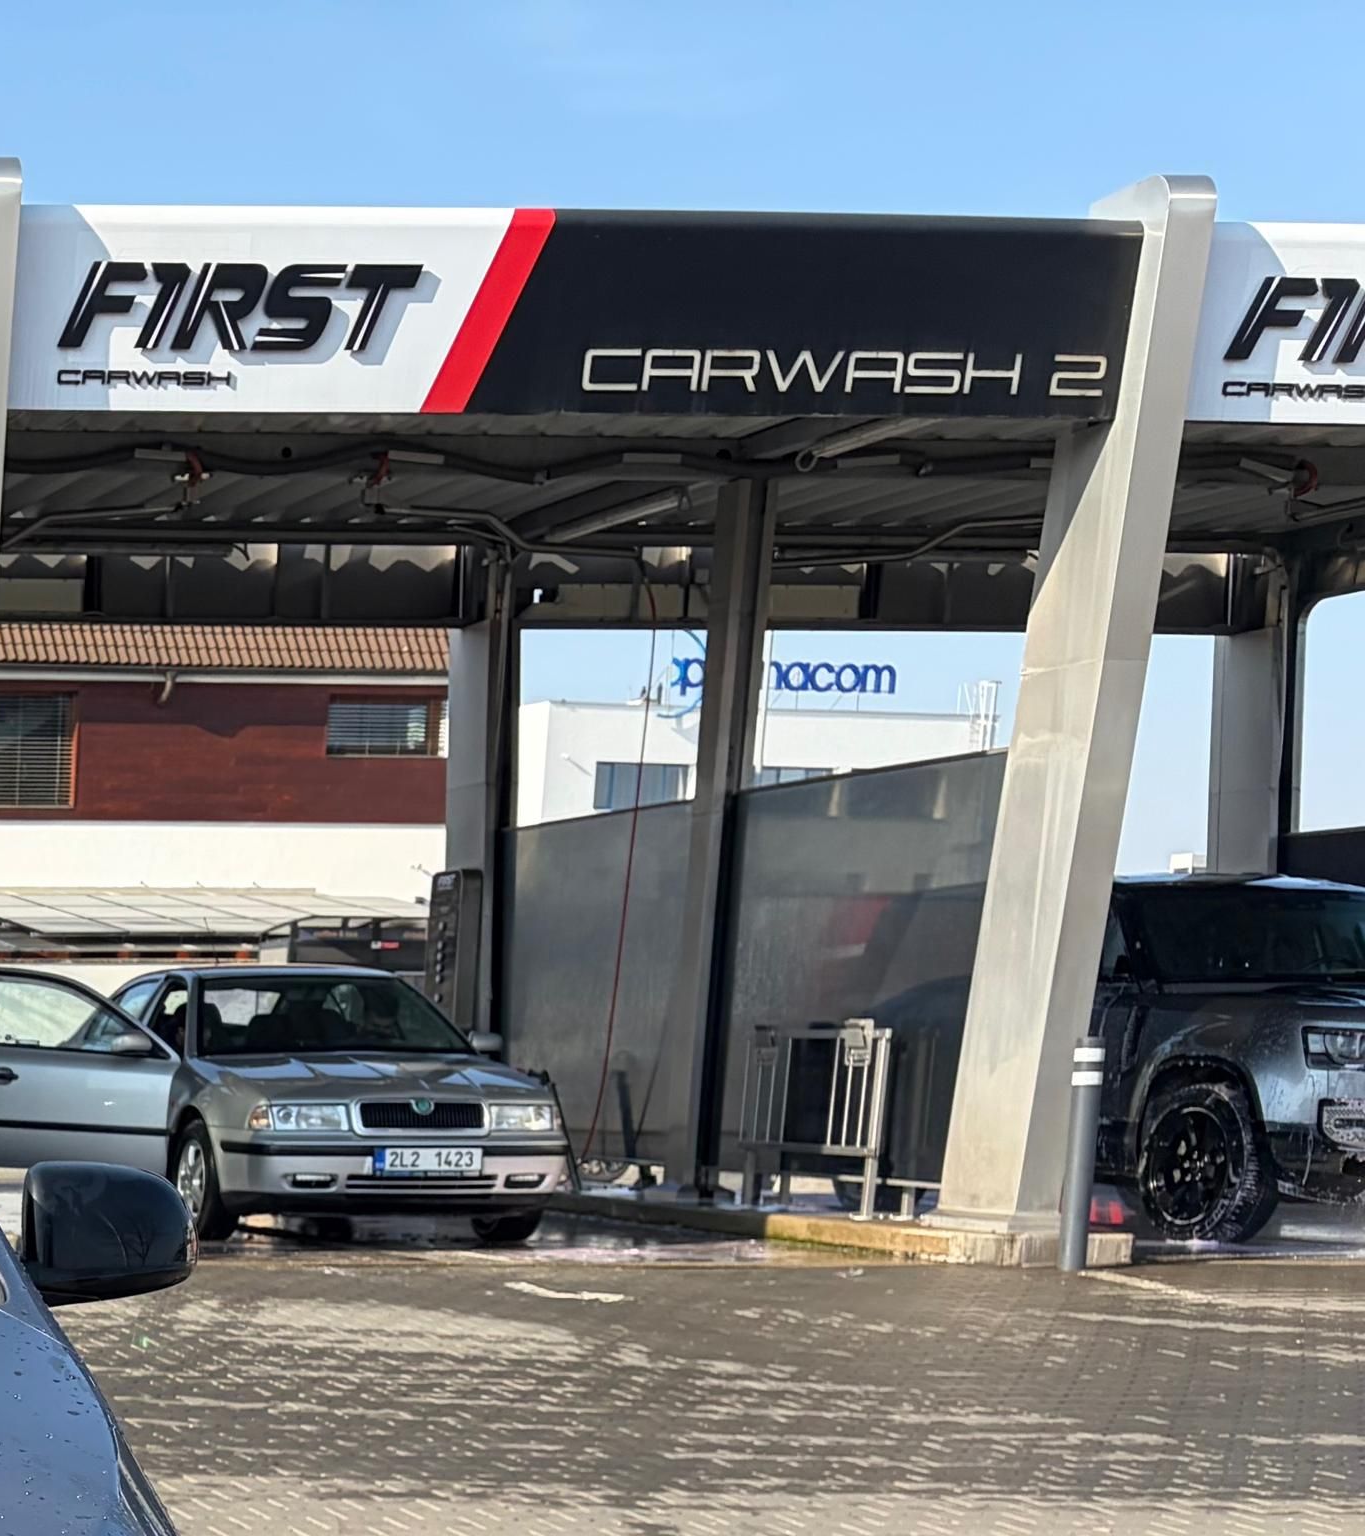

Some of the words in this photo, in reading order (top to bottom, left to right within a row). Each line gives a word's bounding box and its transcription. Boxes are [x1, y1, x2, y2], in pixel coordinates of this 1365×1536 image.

[56, 369, 233, 387] CARWASH
[581, 347, 1022, 396] CARWASH
[1049, 354, 1107, 398] 2
[389, 1151, 420, 1168] 2L2
[435, 1151, 474, 1168] 1423
